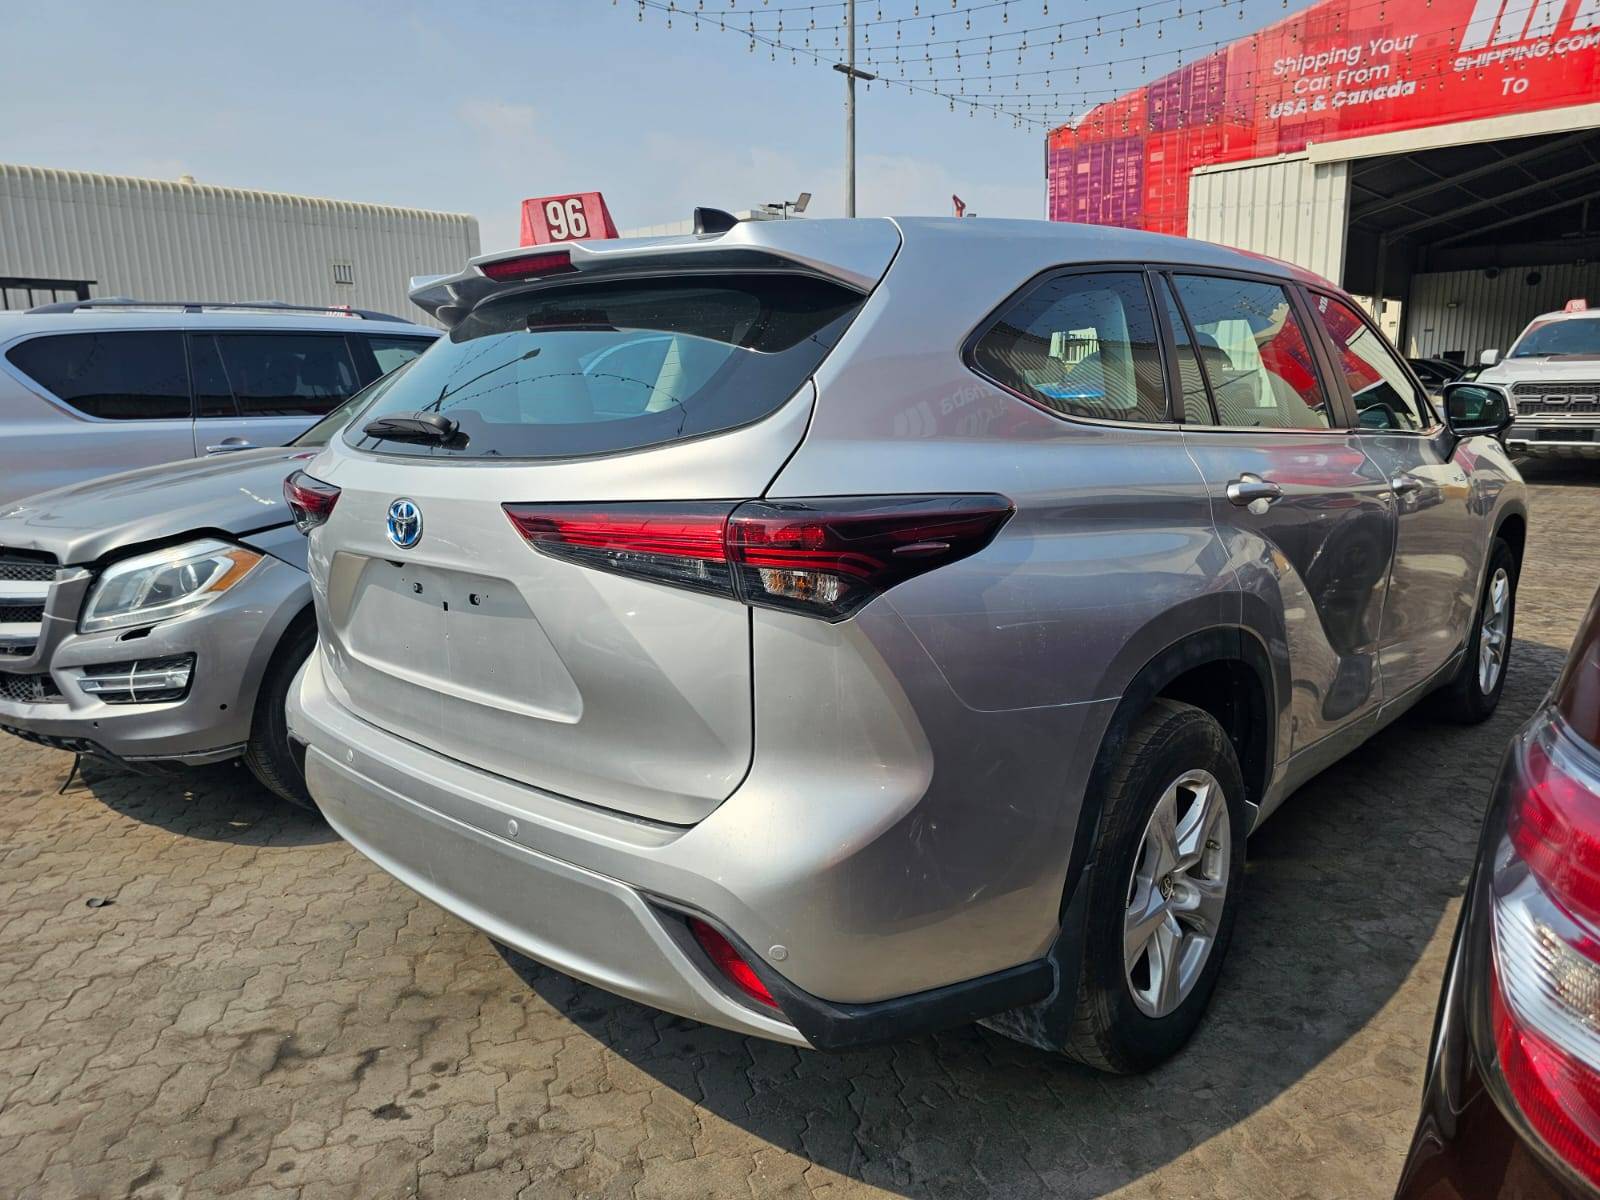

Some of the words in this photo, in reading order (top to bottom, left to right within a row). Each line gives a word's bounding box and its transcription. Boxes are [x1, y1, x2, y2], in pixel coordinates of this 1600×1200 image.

[1273, 45, 1362, 76] Shipping
[1369, 33, 1418, 56] Your
[1269, 98, 1308, 119] USA
[1311, 95, 1328, 112] &
[1331, 79, 1417, 109] Canada
[1294, 75, 1333, 94] Car
[1336, 64, 1390, 87] From
[546, 198, 588, 240] 96
[1513, 394, 1600, 406] FOR
